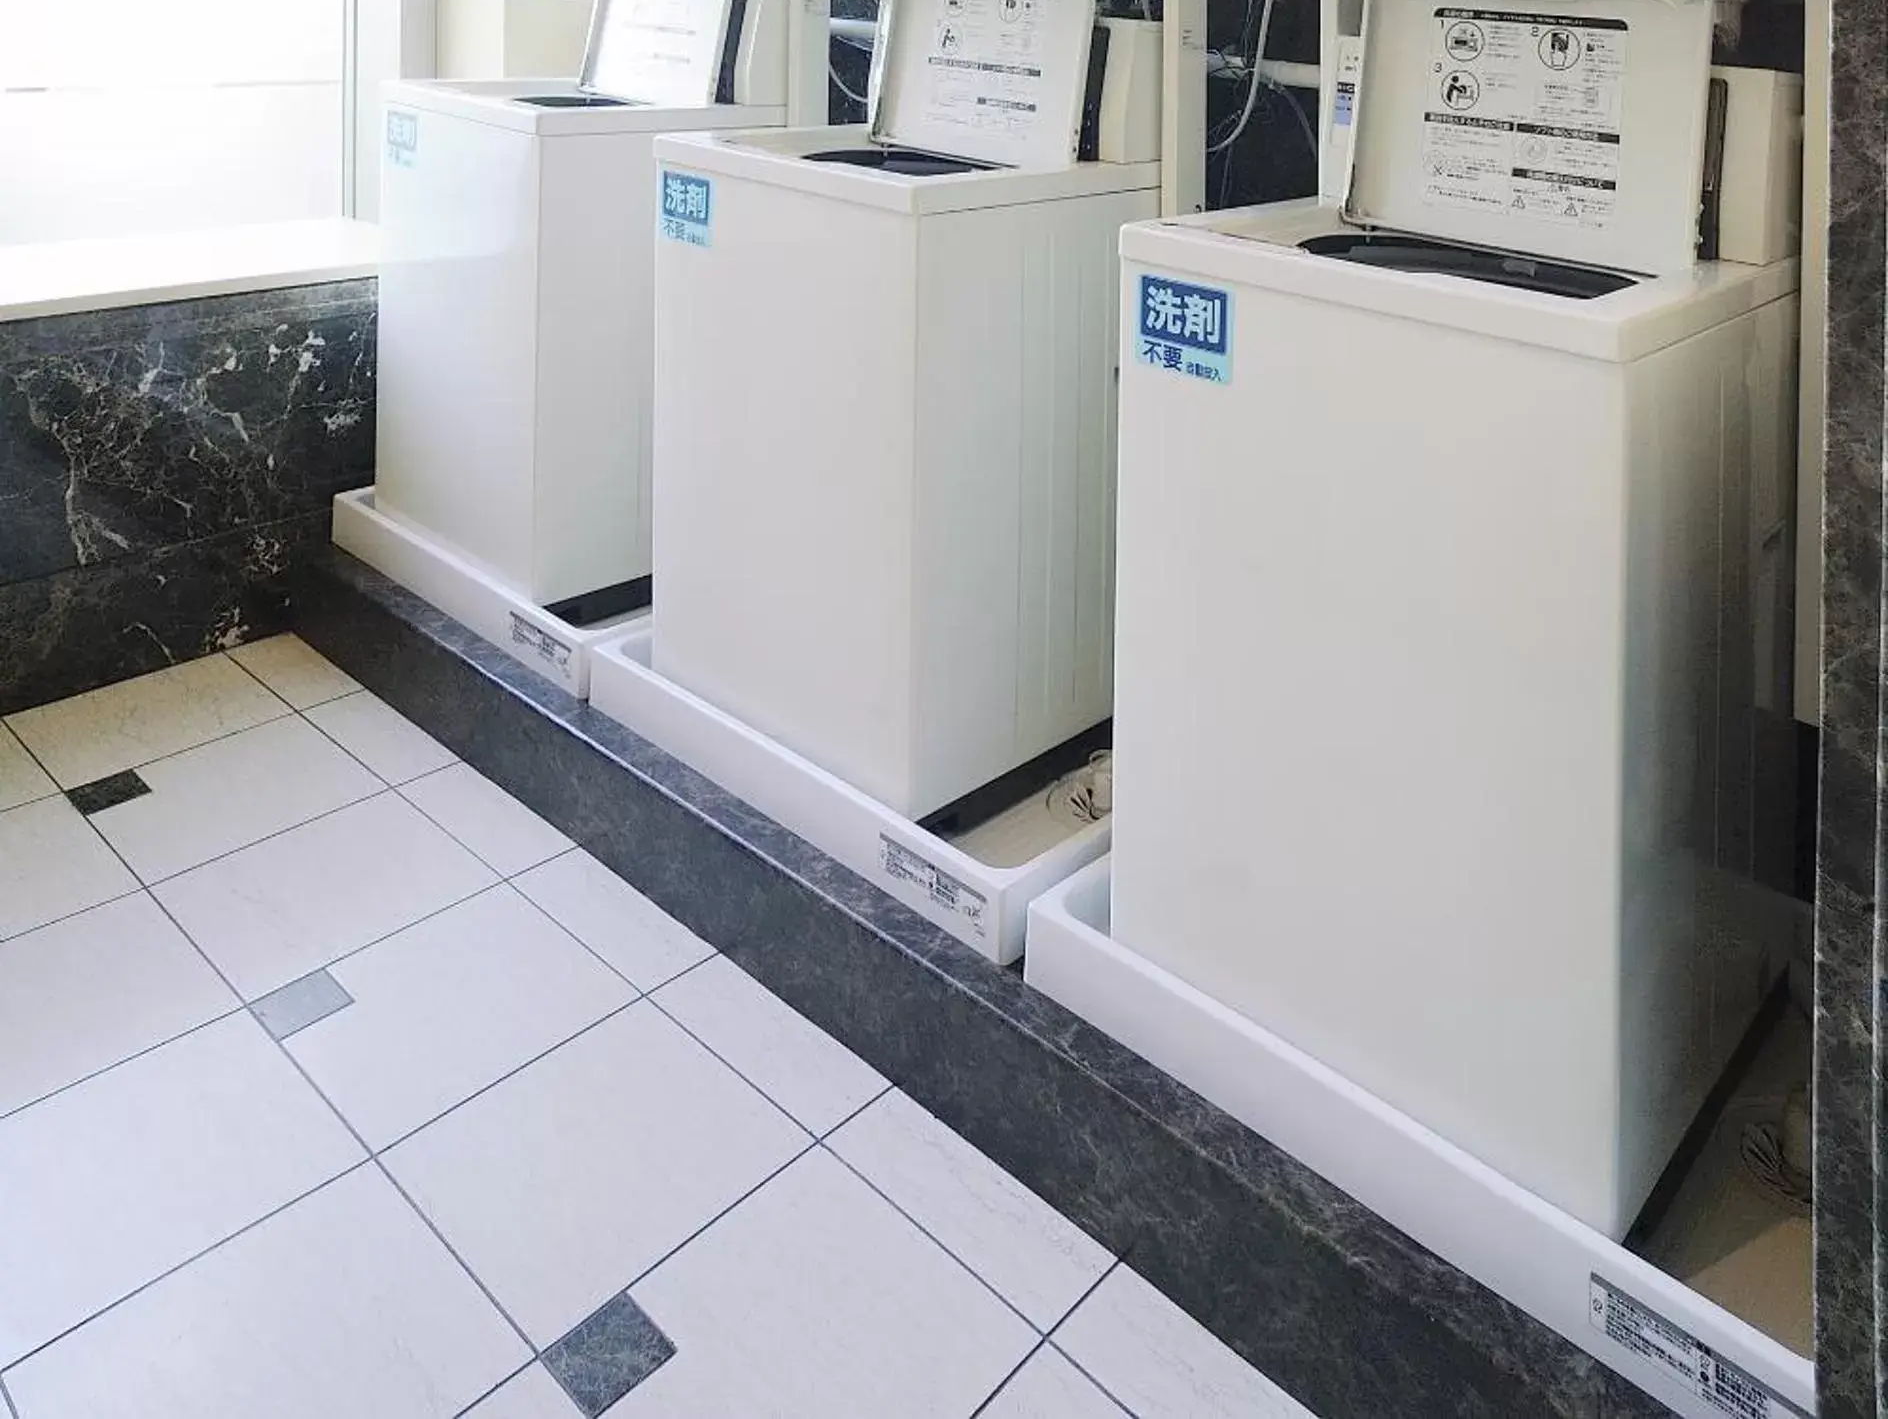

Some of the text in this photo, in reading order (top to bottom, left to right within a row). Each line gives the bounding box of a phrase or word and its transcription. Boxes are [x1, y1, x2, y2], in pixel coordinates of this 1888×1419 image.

[664, 177, 707, 220] 洗剤
[1146, 284, 1222, 344] 洗剤
[1141, 339, 1184, 372] 不要
